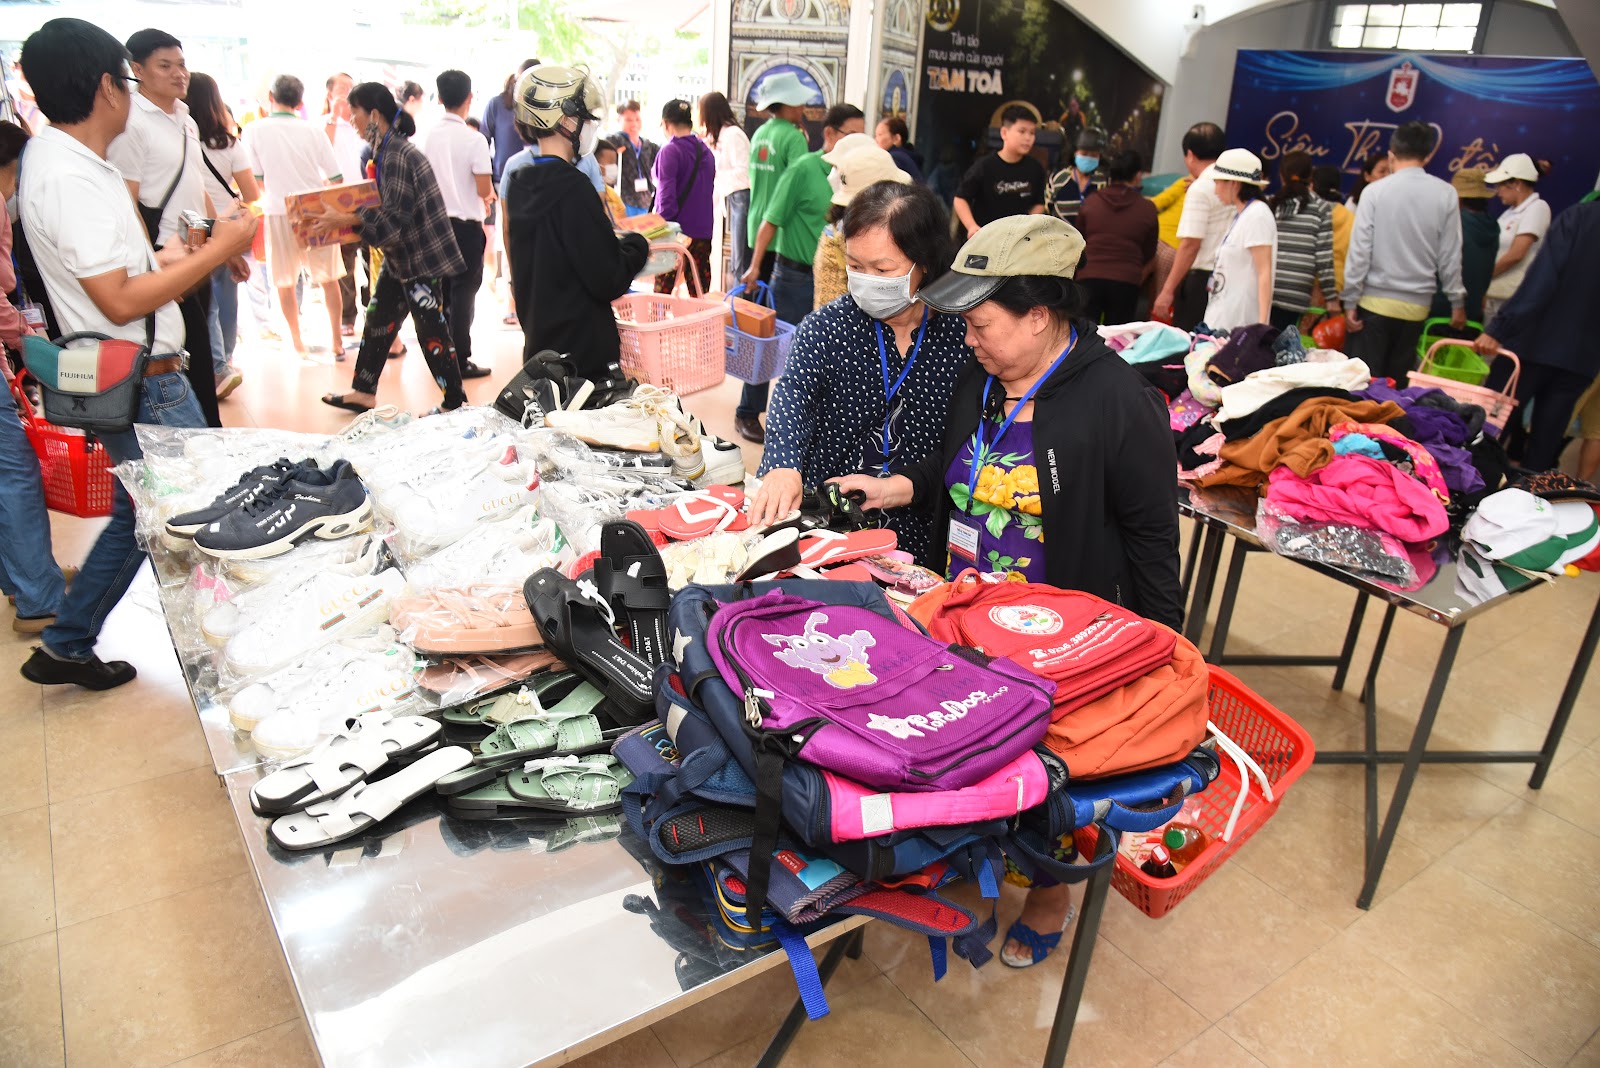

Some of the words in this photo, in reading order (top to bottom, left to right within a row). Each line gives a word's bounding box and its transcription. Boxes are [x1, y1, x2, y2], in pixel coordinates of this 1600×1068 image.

[949, 50, 965, 62] sinh
[927, 65, 966, 92] TAM
[60, 371, 94, 380] FUJIFILM
[1046, 448, 1056, 466] NEW
[1050, 467, 1061, 495] MODEL
[482, 492, 520, 511] GUCCI
